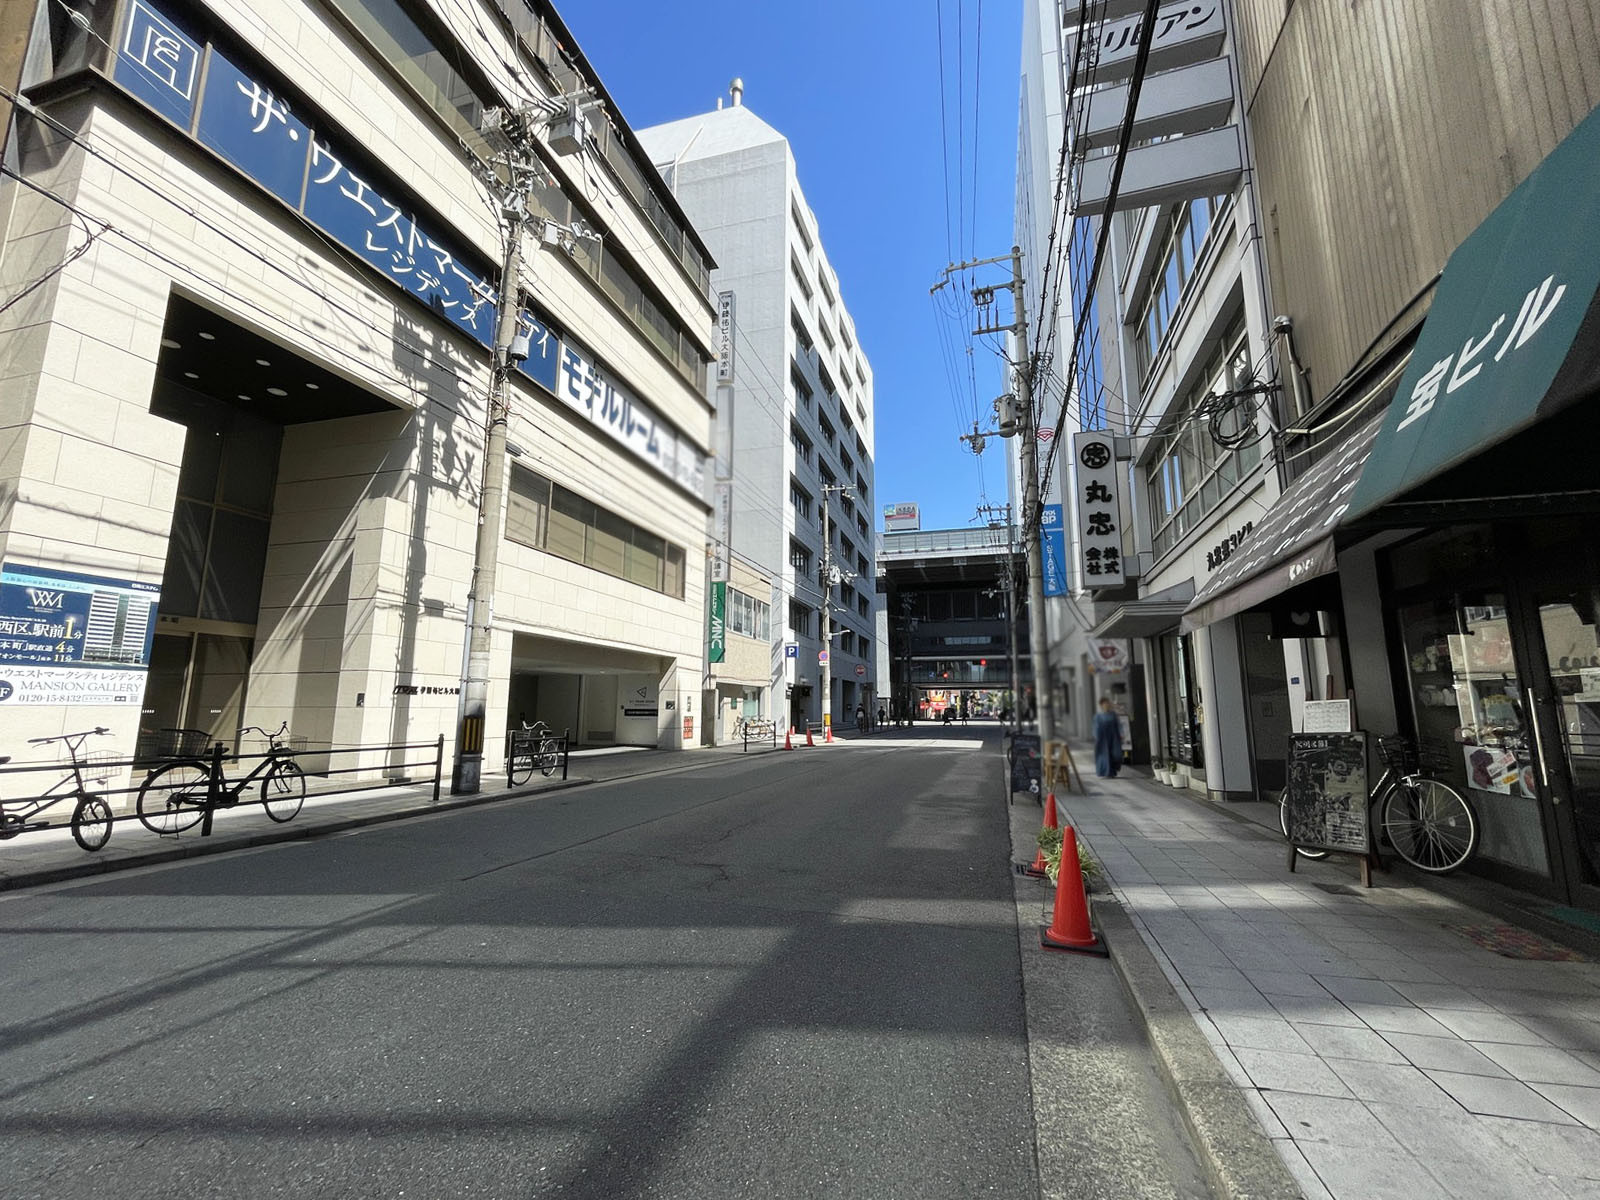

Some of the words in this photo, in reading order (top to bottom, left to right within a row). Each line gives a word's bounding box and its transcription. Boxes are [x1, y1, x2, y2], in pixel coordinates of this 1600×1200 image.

[236, 81, 550, 358] ザ・ウエストマークティ
[366, 230, 477, 330] レジデンス
[562, 347, 660, 460] モデルルーム
[1085, 480, 1115, 536] 丸忠
[711, 615, 723, 649] MNC
[788, 647, 796, 656] P
[20, 680, 84, 691] MANSION
[87, 682, 142, 693] GALLERY
